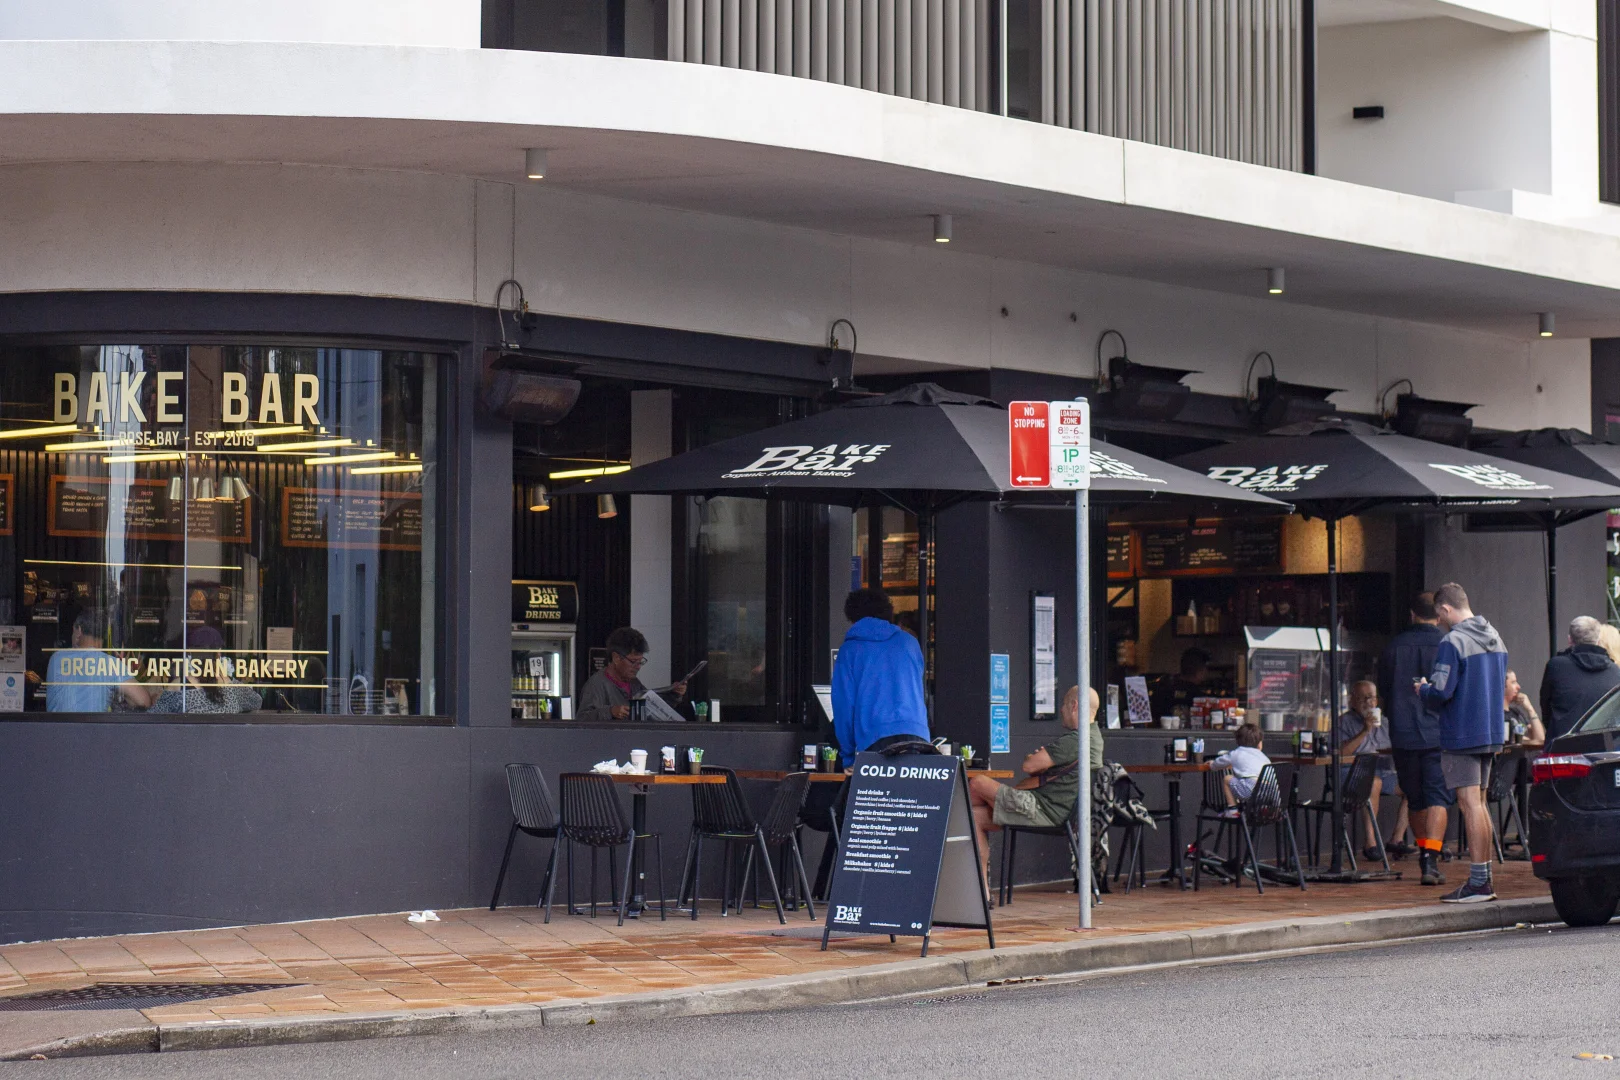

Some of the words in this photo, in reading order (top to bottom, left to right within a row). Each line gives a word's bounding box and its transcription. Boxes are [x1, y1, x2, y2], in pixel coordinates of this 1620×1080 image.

[54, 371, 183, 424] BAKE
[222, 372, 320, 425] BAR
[1024, 407, 1034, 416] NO
[1014, 418, 1045, 428] STOPPING
[118, 430, 151, 446] ROSE
[157, 431, 180, 446] BAY
[195, 431, 222, 446] EST
[224, 432, 255, 446] 2019
[1063, 449, 1079, 462] 1P
[525, 610, 561, 619] DRINKS
[60, 657, 138, 676] ORGANIC
[146, 657, 228, 678] ARTISAN
[236, 659, 308, 679] BAKERY
[531, 659, 542, 667] 19
[860, 764, 896, 778] COLD
[900, 766, 950, 780] DRINKS
